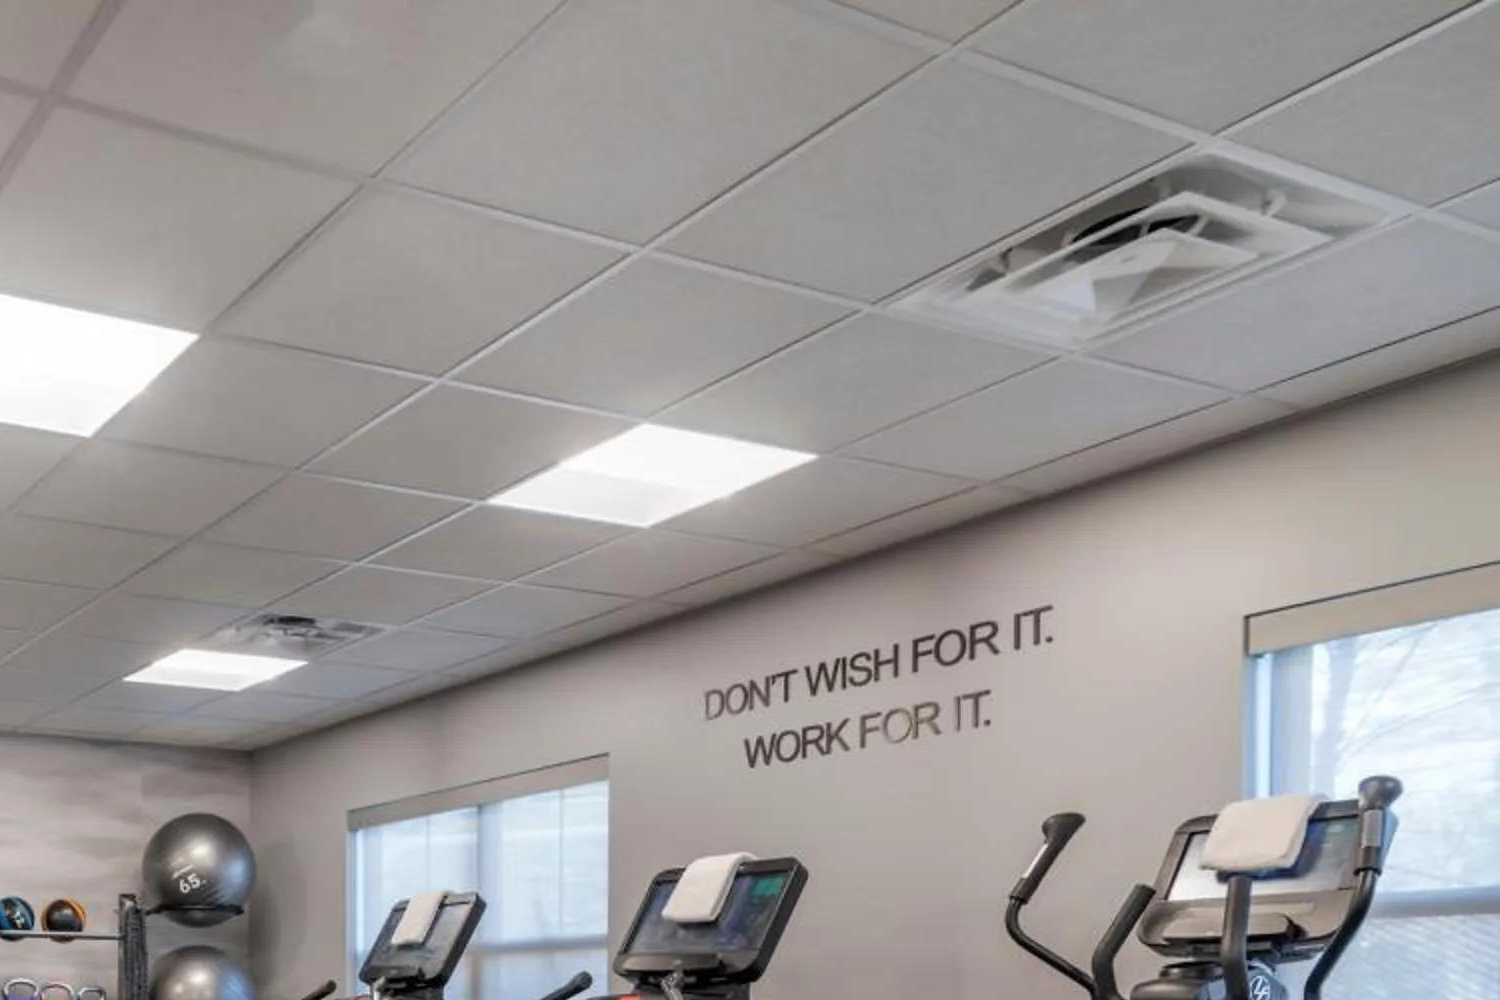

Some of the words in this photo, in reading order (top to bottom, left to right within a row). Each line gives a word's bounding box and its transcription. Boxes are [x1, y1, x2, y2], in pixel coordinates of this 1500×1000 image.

[704, 669, 798, 720] DON'T
[805, 644, 900, 697] WISH
[911, 620, 1000, 674] FOR
[1013, 604, 1054, 650] IT.
[743, 718, 851, 769] WORK
[859, 701, 942, 749] FOR
[955, 690, 992, 731] IT.
[179, 873, 201, 893] 65
